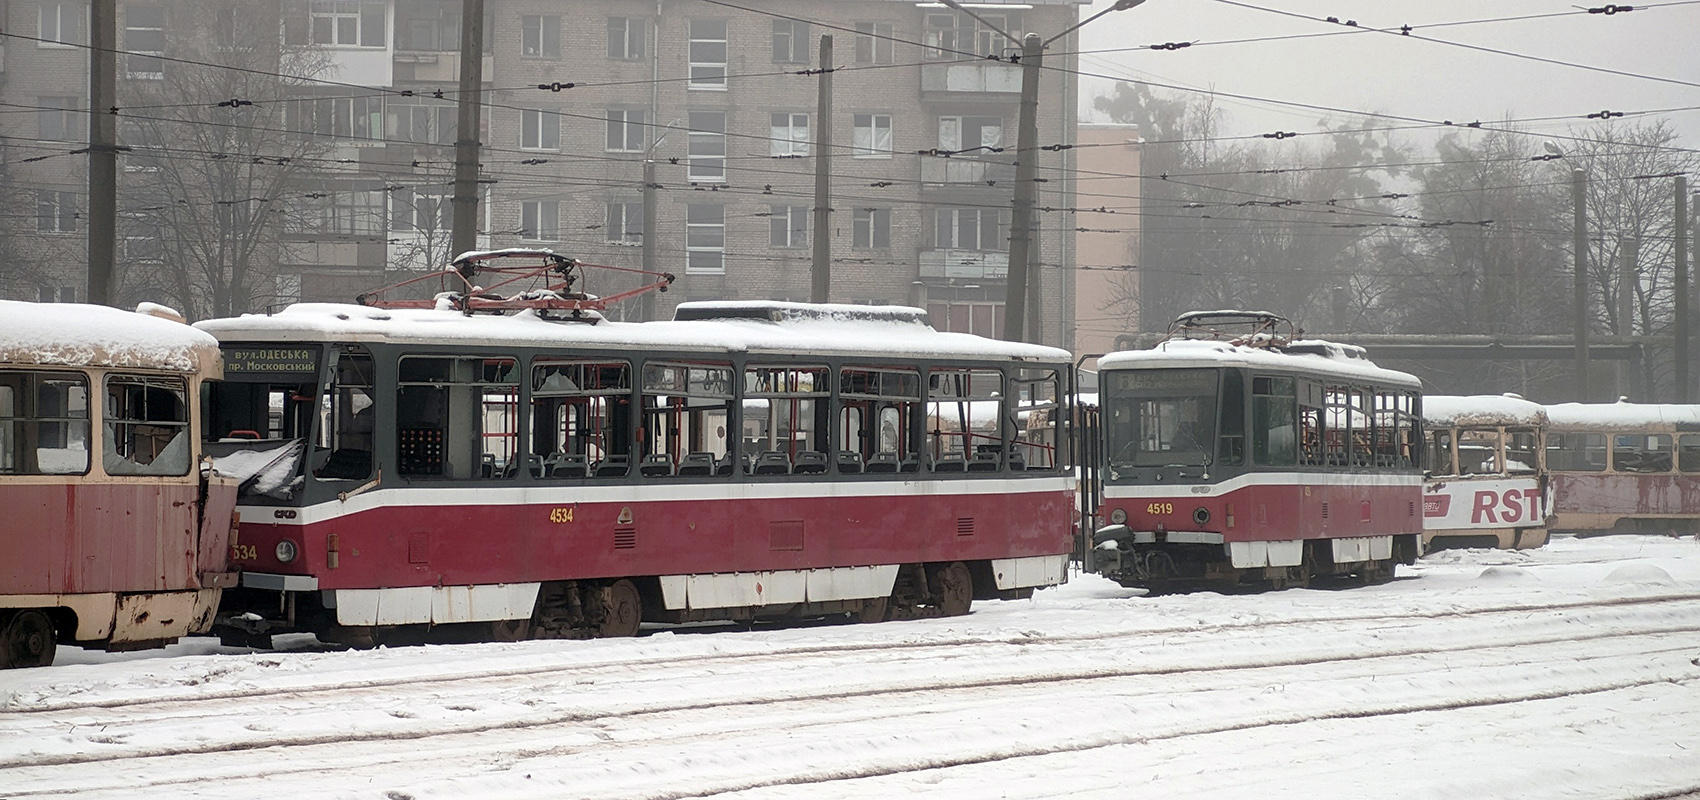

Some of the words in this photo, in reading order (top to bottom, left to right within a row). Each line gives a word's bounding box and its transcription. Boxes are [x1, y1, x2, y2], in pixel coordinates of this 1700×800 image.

[228, 363, 244, 371] пр.
[247, 361, 315, 371] Московський
[1147, 503, 1173, 514] 4519
[1471, 488, 1541, 524] RST
[549, 507, 574, 523] 4534
